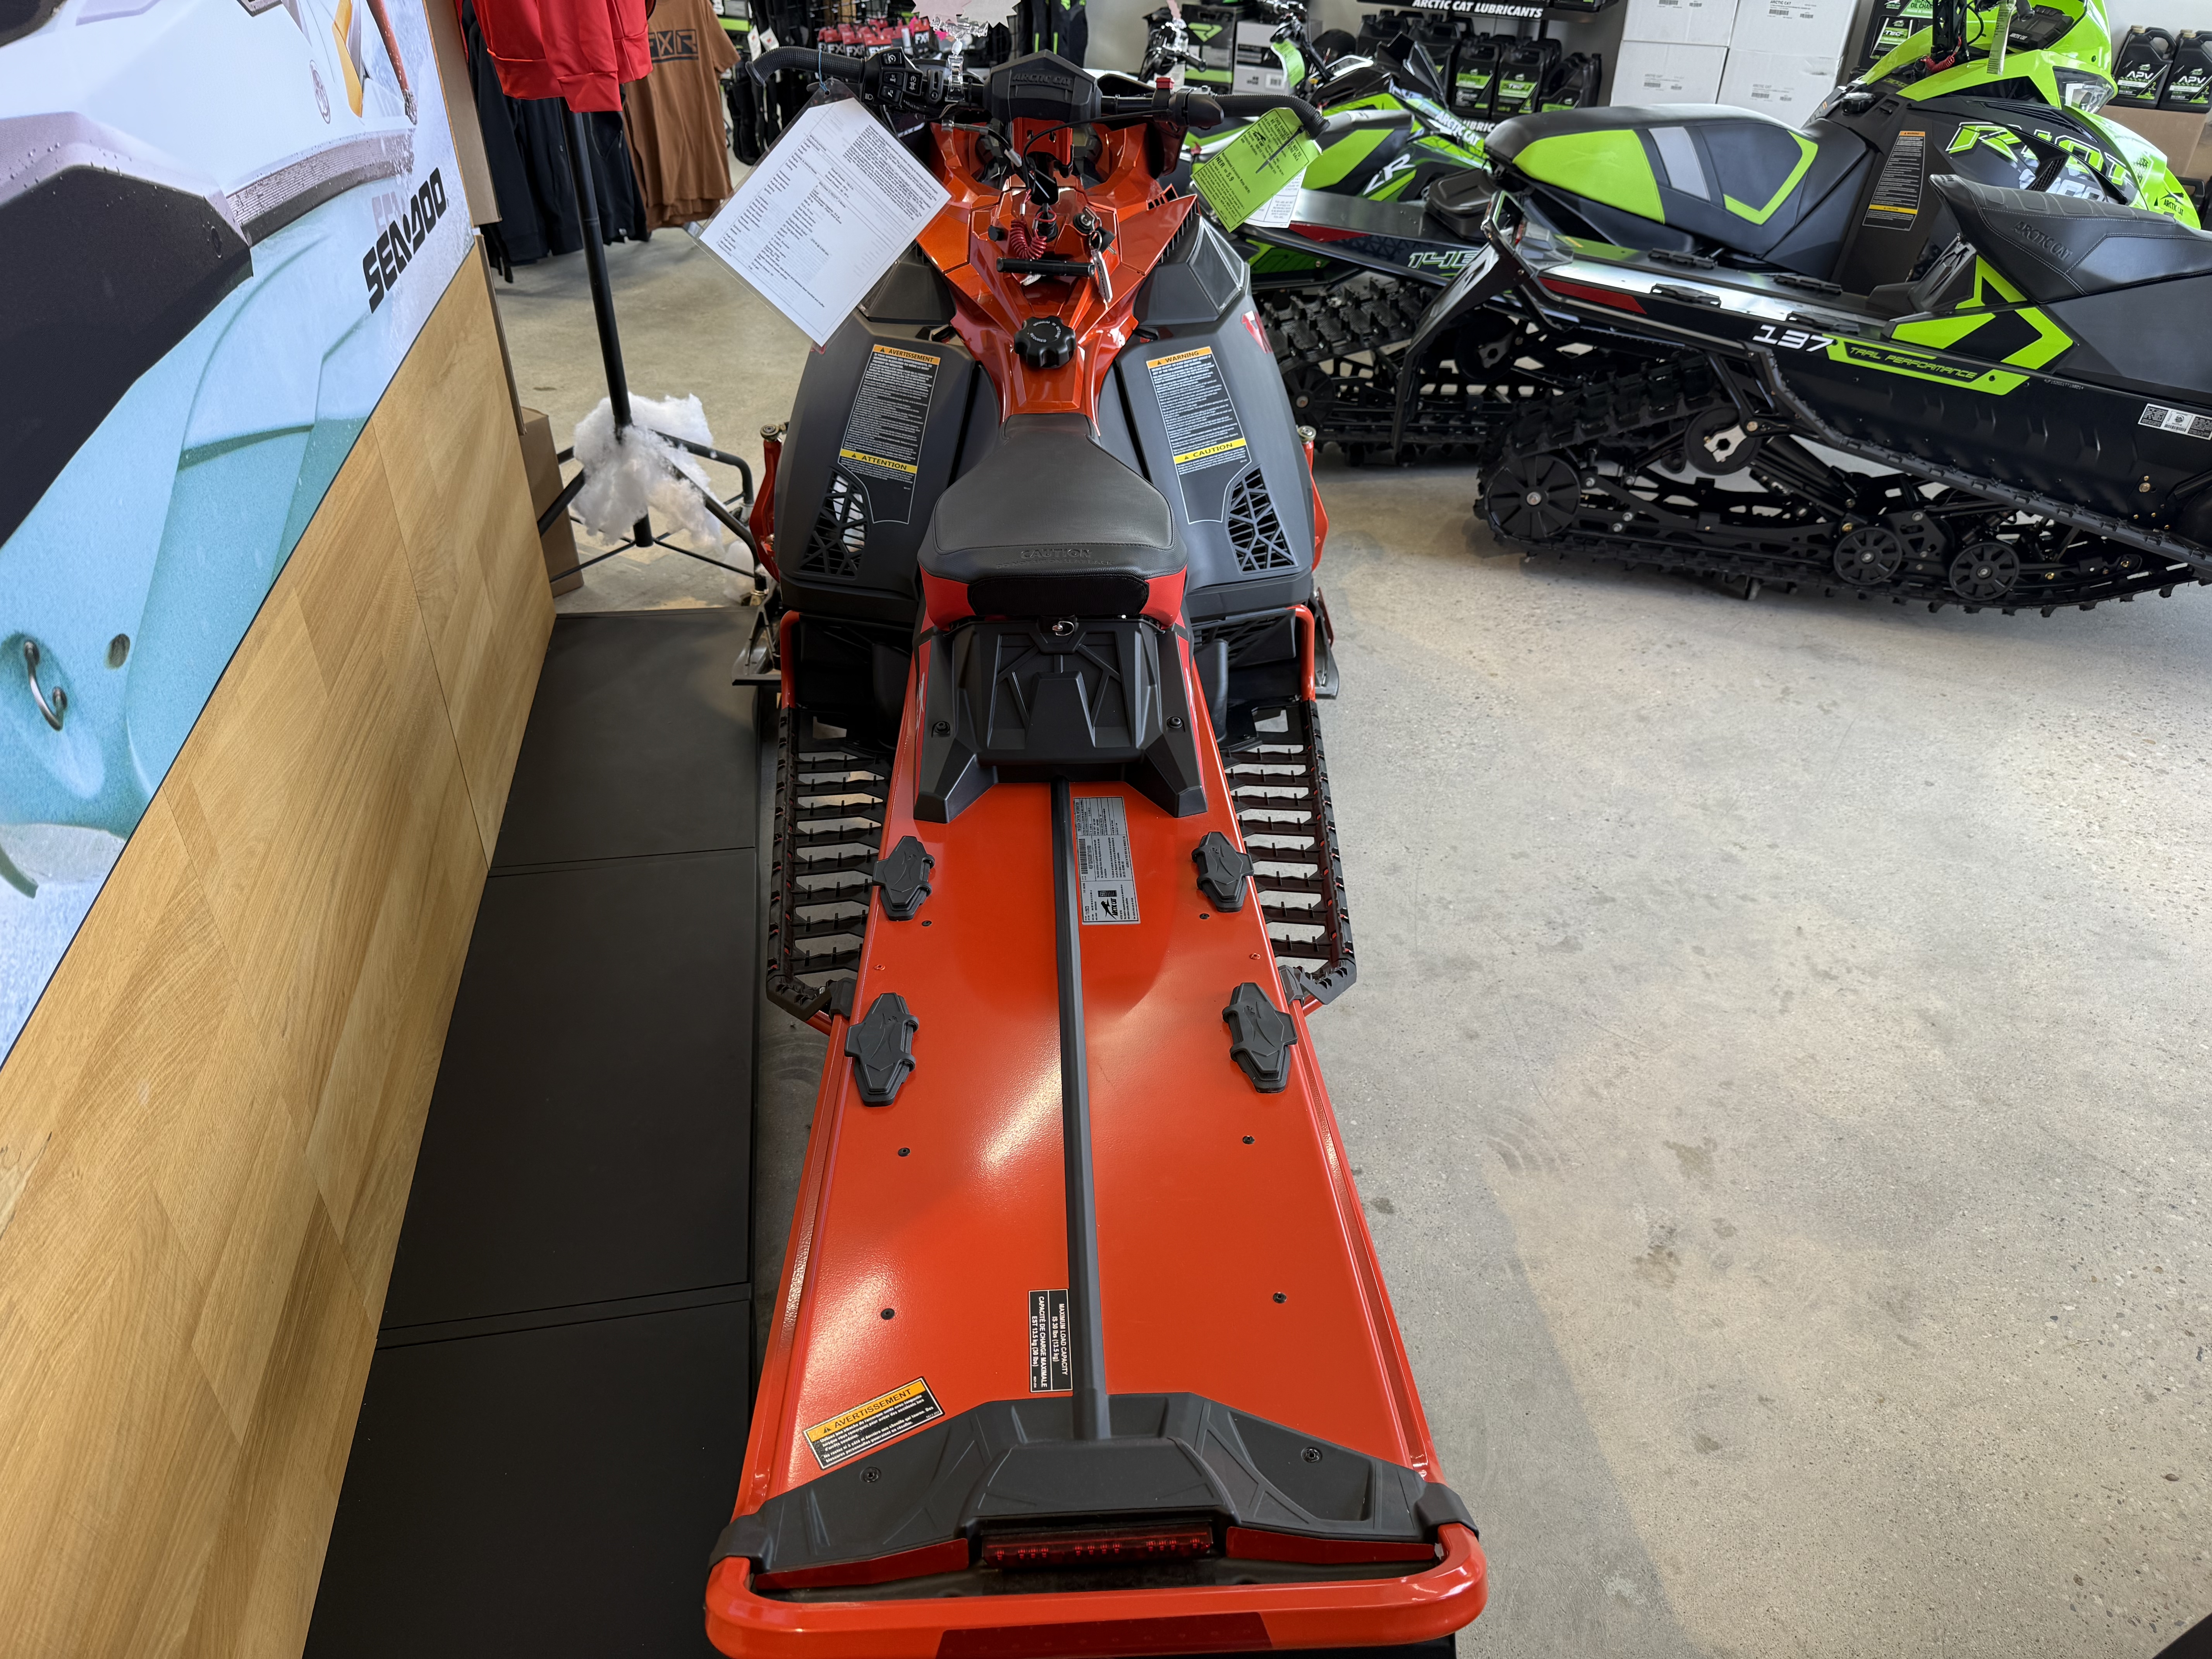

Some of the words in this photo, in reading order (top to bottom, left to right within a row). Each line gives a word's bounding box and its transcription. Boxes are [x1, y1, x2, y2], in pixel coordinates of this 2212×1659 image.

[1412, 0, 1451, 10] ARCTIC
[1452, 1, 1474, 12] CAT
[1474, 3, 1544, 18] LUBRICANTS
[1012, 73, 1051, 84] ARCTIC
[1053, 77, 1072, 86] CAT
[2126, 70, 2154, 80] APV
[2178, 76, 2207, 84] APV
[1273, 124, 1287, 141] REMOVED
[1274, 117, 1282, 125] THIS
[1279, 124, 1292, 140] HANGTA
[1435, 111, 1465, 137] ARCTIC
[1463, 129, 1480, 146] CAT
[1252, 132, 1261, 142] ARCTIC
[1215, 156, 1226, 168] NER
[1225, 172, 1235, 182] 5.9
[2163, 199, 2177, 212] ARCTIC
[2011, 220, 2053, 249] ARCTIC
[2051, 241, 2073, 261] CAT
[1752, 324, 1834, 352] 137
[888, 349, 934, 362] AVERTISSEMENT
[1165, 350, 1199, 363] WARNING
[1849, 346, 1882, 359] TRAIL
[1884, 354, 1977, 379] PERFORMANCE
[1193, 442, 1233, 457] CAUTION
[861, 455, 907, 470] ATTENTION
[1021, 549, 1091, 559] CAUTION
[833, 1388, 912, 1428] AVERTISSEMENT
